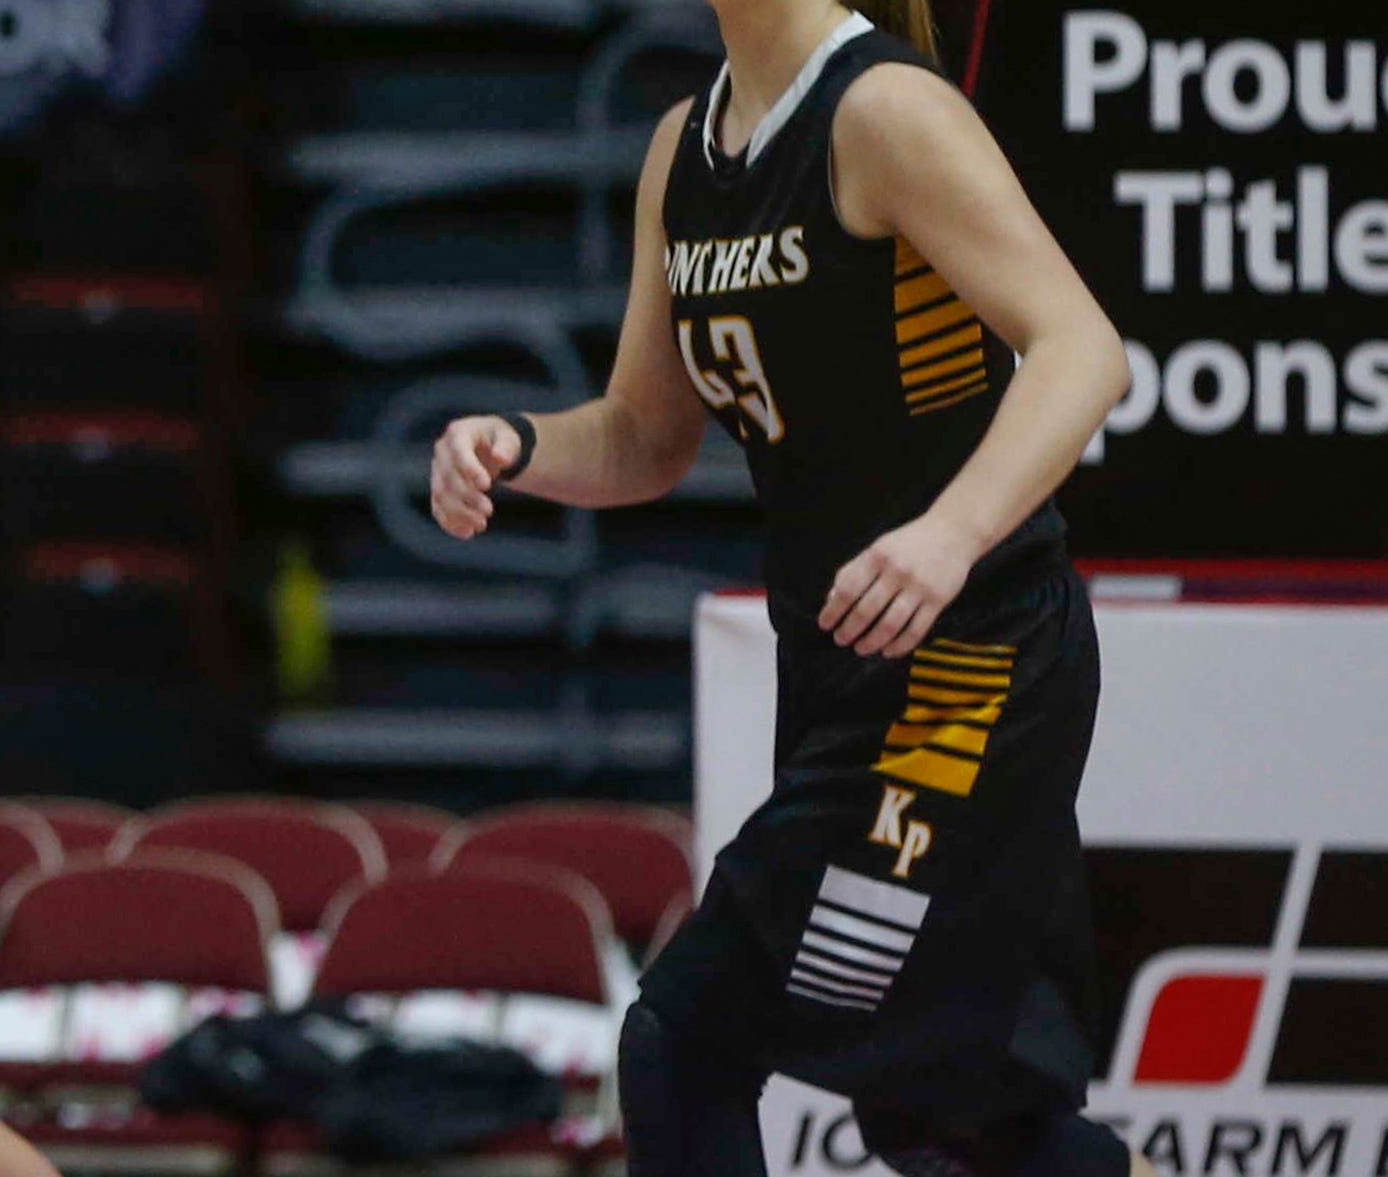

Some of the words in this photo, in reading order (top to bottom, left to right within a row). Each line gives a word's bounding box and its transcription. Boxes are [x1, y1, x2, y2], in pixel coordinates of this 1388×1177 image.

[1062, 10, 1388, 134] Prou
[664, 225, 810, 298] NTHERS
[1113, 165, 1388, 294] Title
[1079, 337, 1388, 465] pons
[869, 784, 933, 878] KP
[1096, 1116, 1350, 1177] ARM
